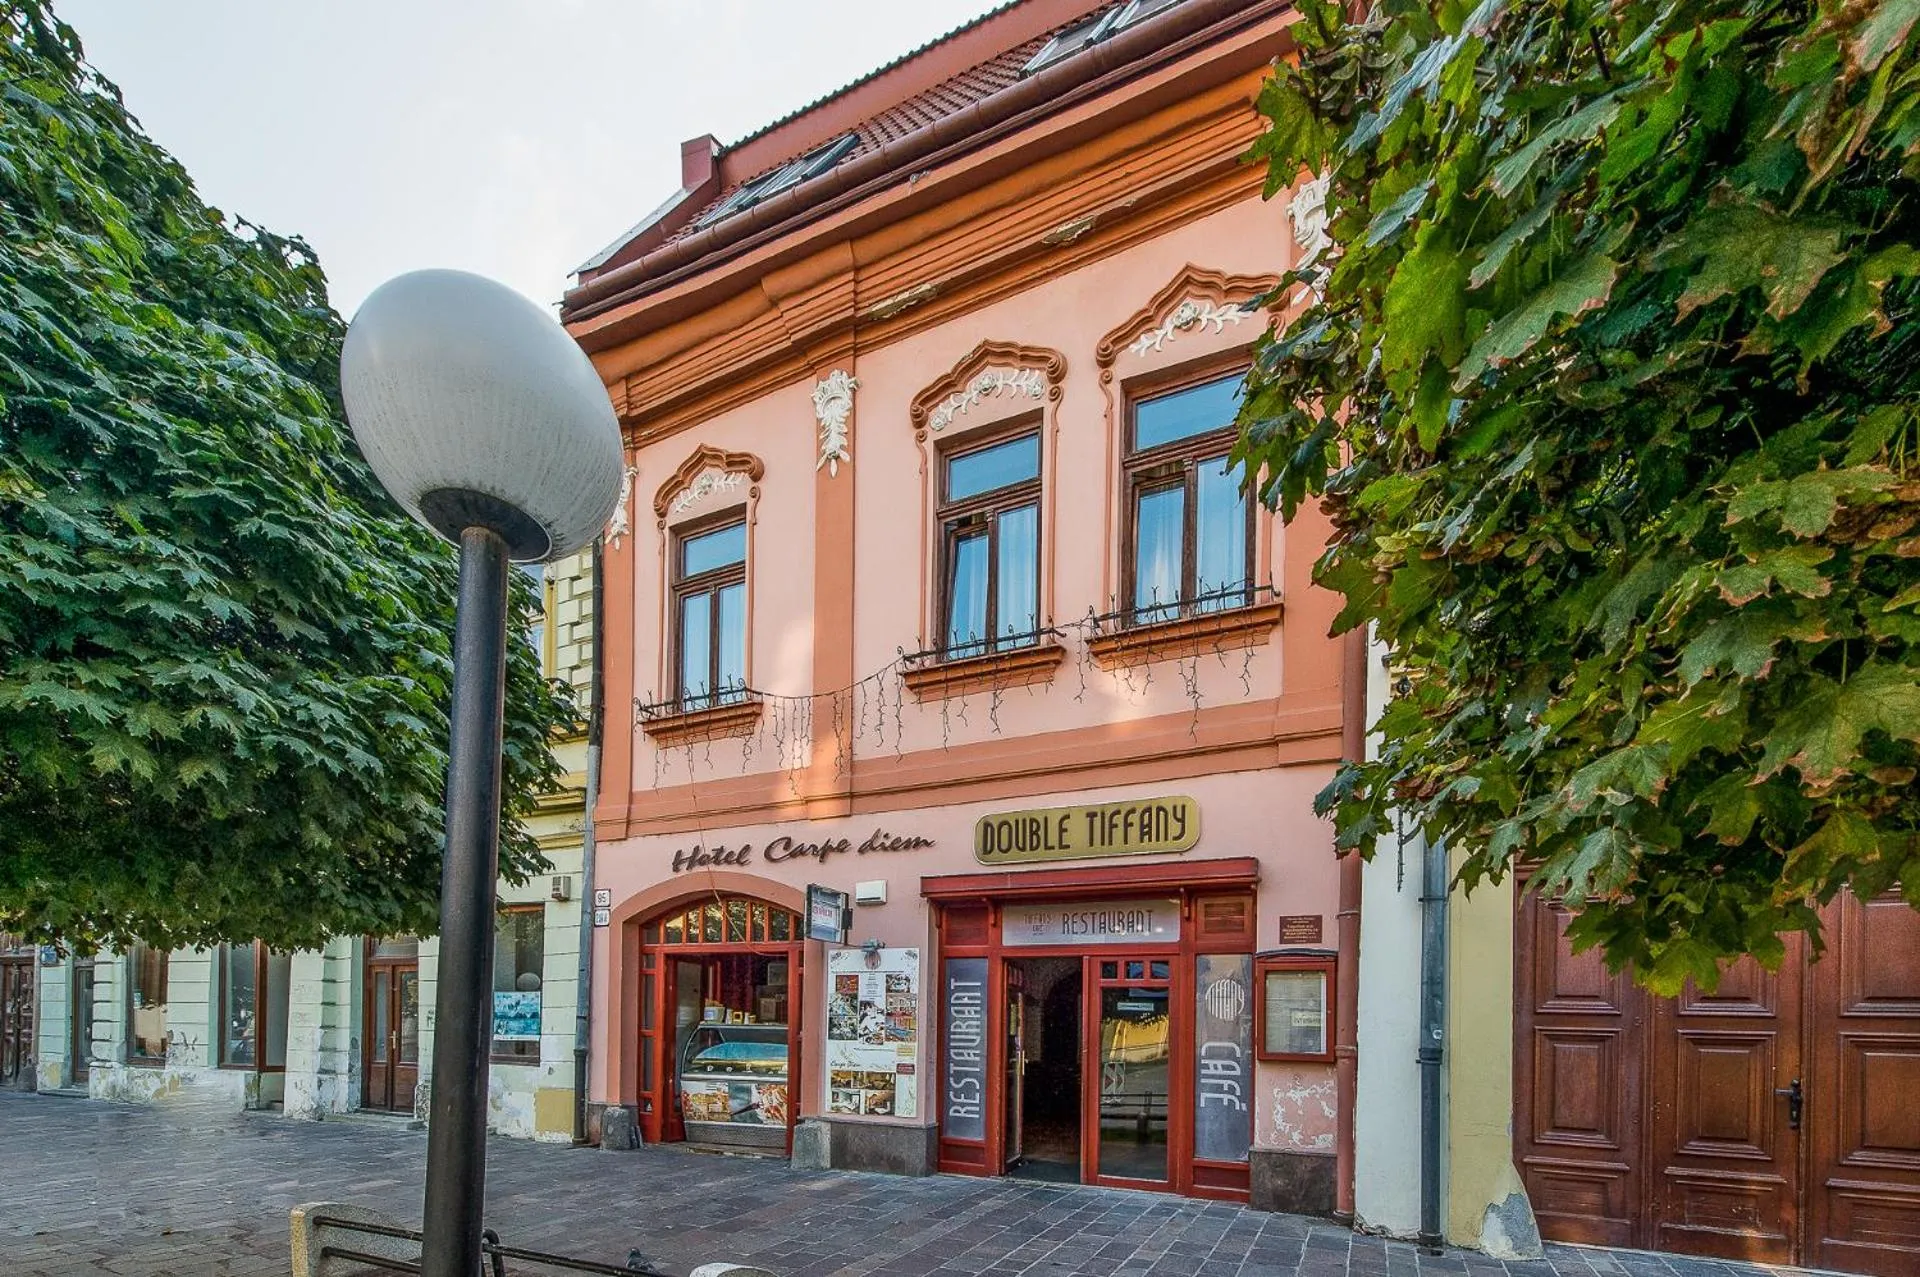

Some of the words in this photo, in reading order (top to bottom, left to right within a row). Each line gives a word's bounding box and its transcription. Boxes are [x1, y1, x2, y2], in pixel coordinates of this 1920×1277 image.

[671, 844, 751, 873] Hotel
[763, 836, 852, 863] Carpe
[857, 828, 936, 855] diem
[982, 814, 1071, 856] DOUBLE
[1085, 804, 1187, 848] TIFFANY
[1062, 909, 1153, 936] RESTAURANT
[950, 978, 982, 1119] RESTAURANT
[1200, 1042, 1247, 1112] CAFÉ
